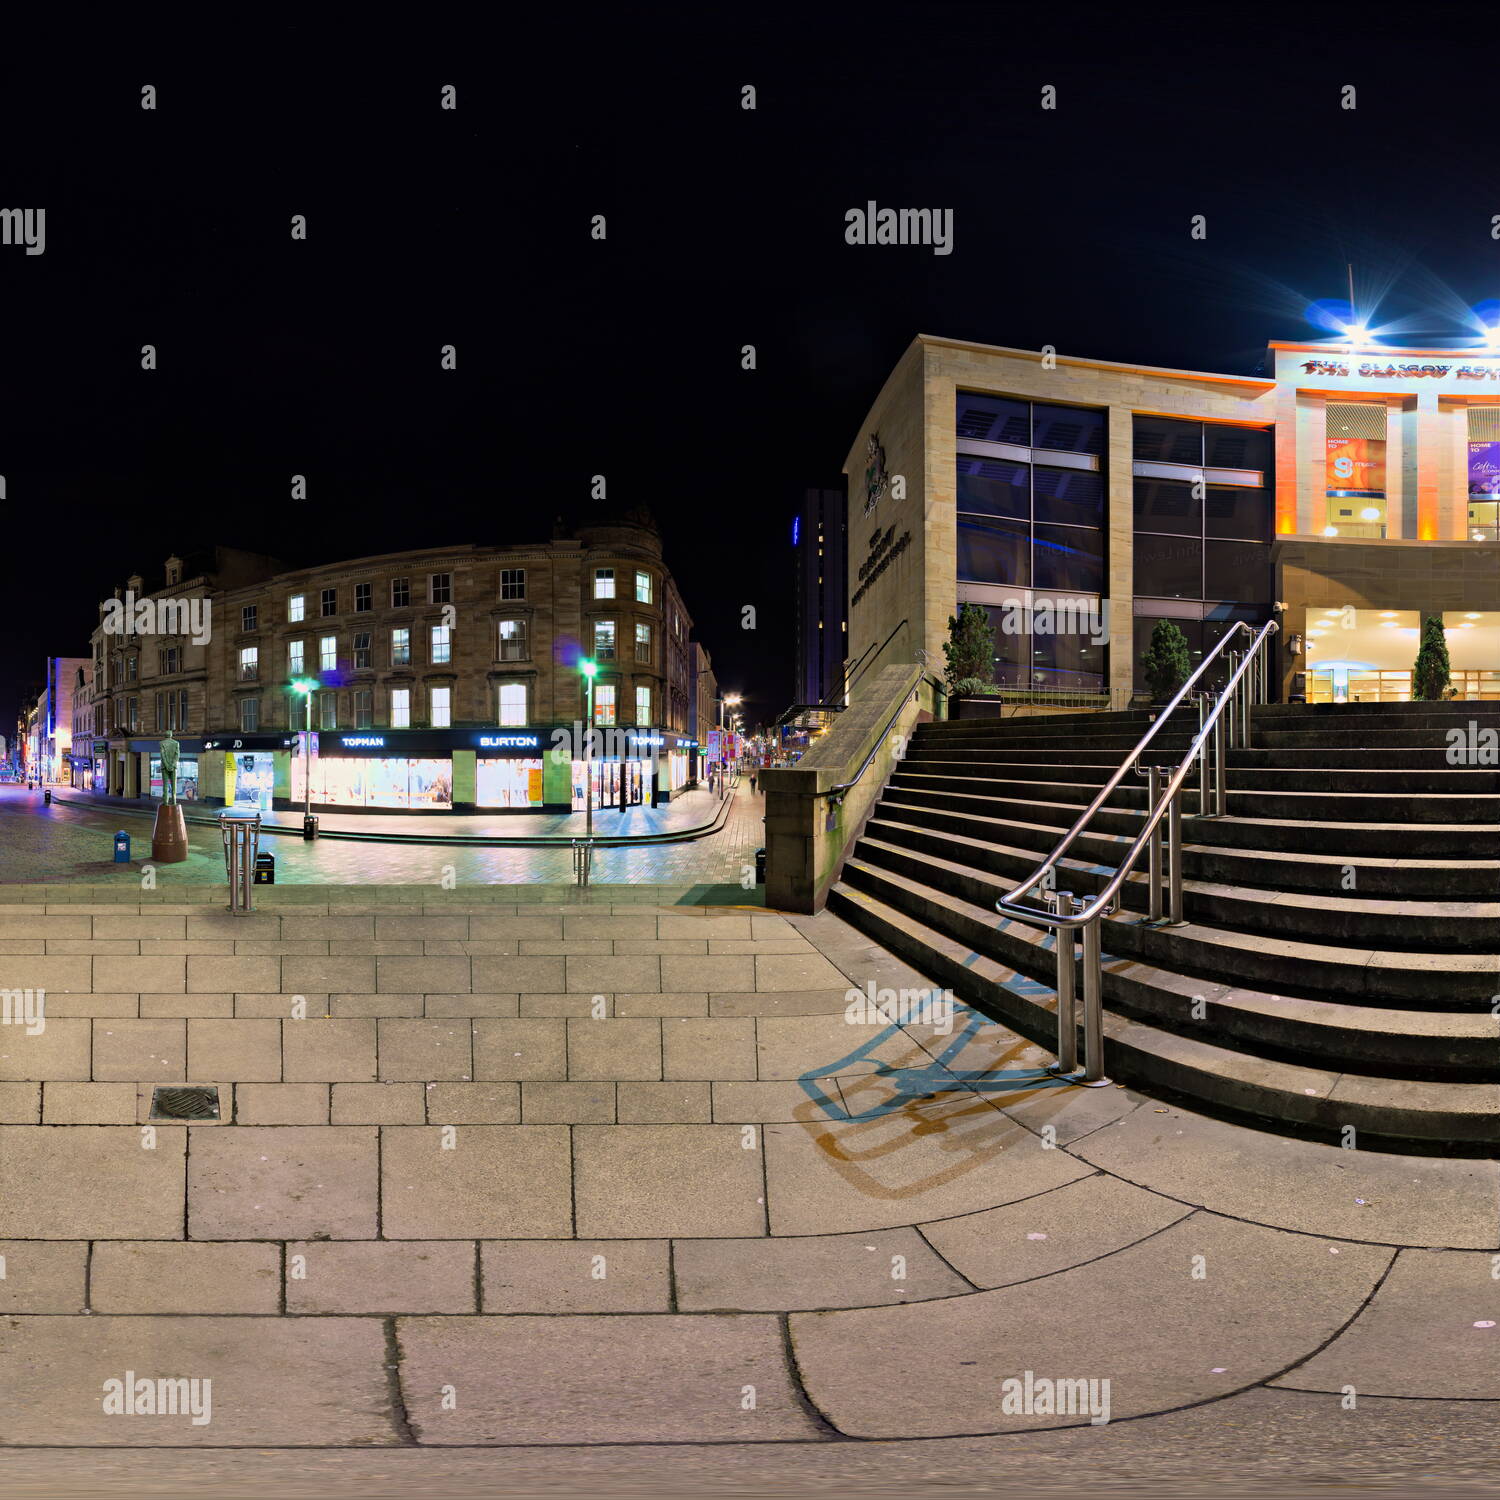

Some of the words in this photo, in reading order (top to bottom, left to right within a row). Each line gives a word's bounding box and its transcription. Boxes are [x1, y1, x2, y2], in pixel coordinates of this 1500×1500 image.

[1359, 363, 1453, 378] GLASGOW
[232, 739, 243, 749] JD
[342, 737, 384, 746] TOPMAN
[480, 736, 537, 746] BURTON
[630, 736, 664, 746] TOPMAN
